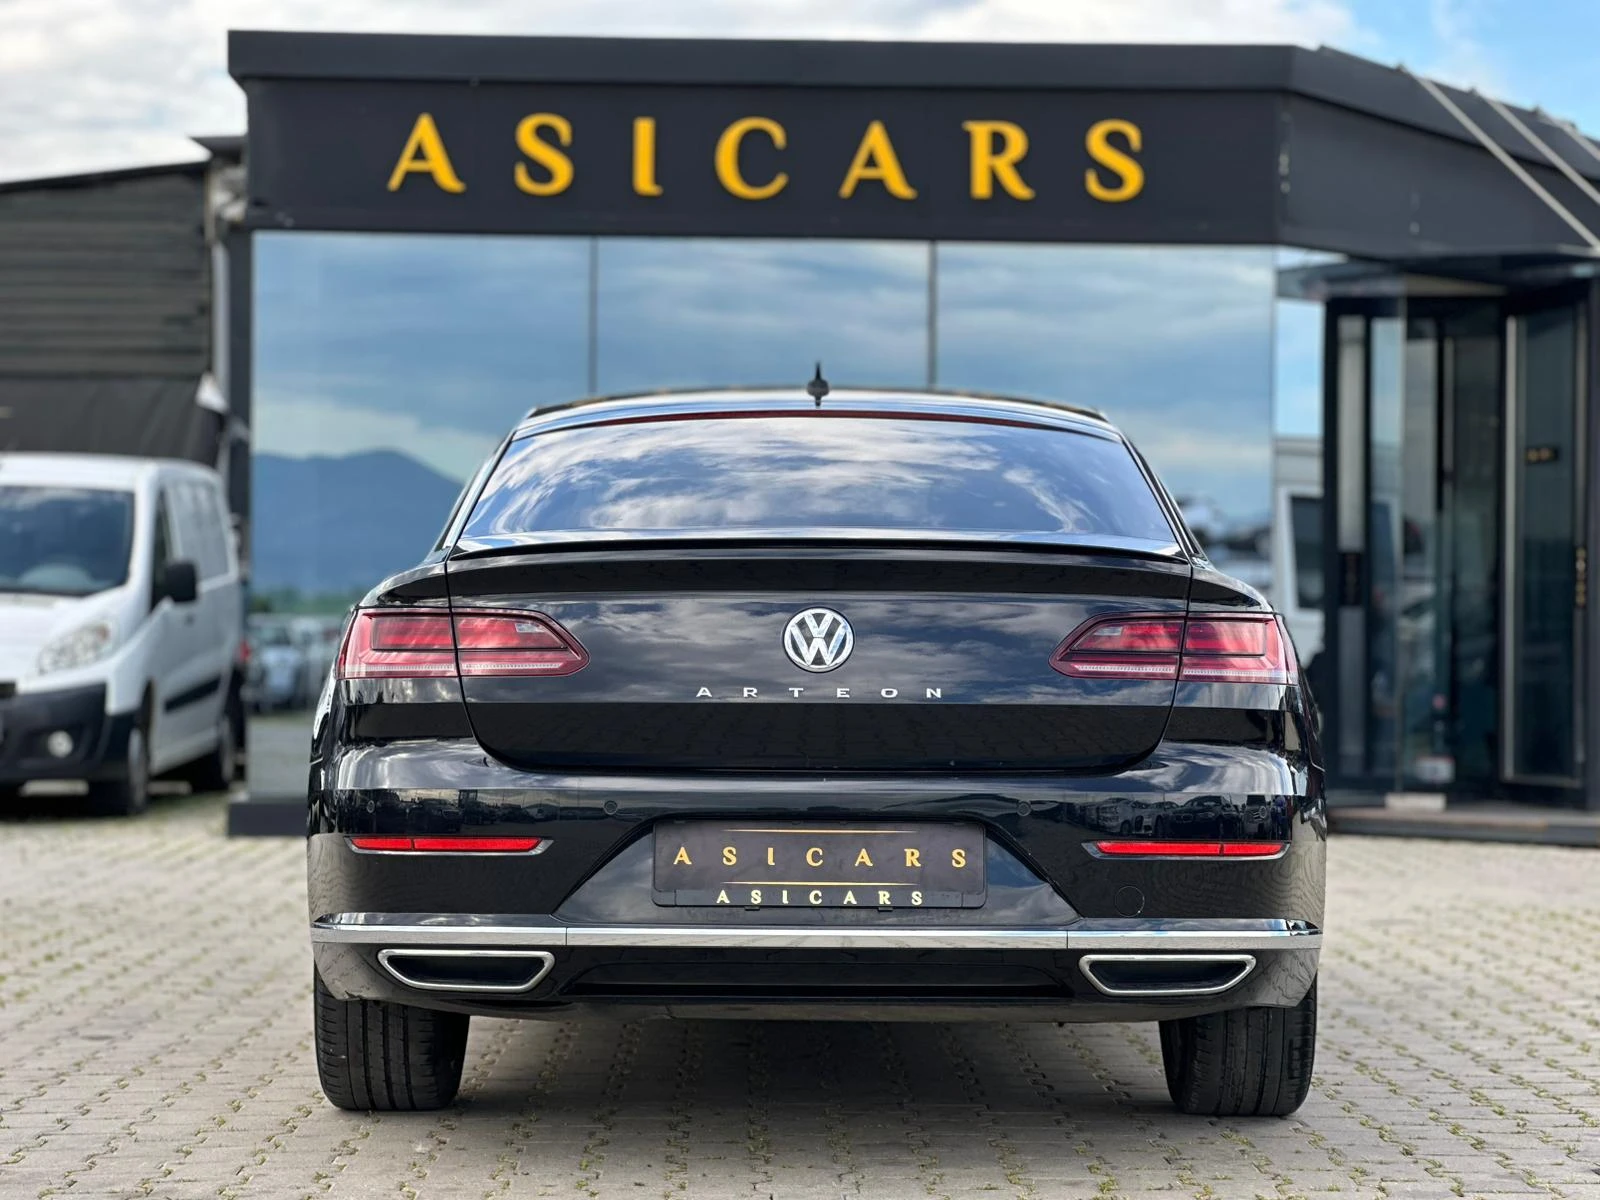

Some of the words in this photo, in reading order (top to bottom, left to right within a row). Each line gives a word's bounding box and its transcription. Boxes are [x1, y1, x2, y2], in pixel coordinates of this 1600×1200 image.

[387, 112, 1146, 203] ASICARS
[784, 609, 852, 670] VW
[695, 686, 943, 699] ARTEON
[672, 846, 967, 869] ASICARS
[715, 889, 923, 906] ASICARS
